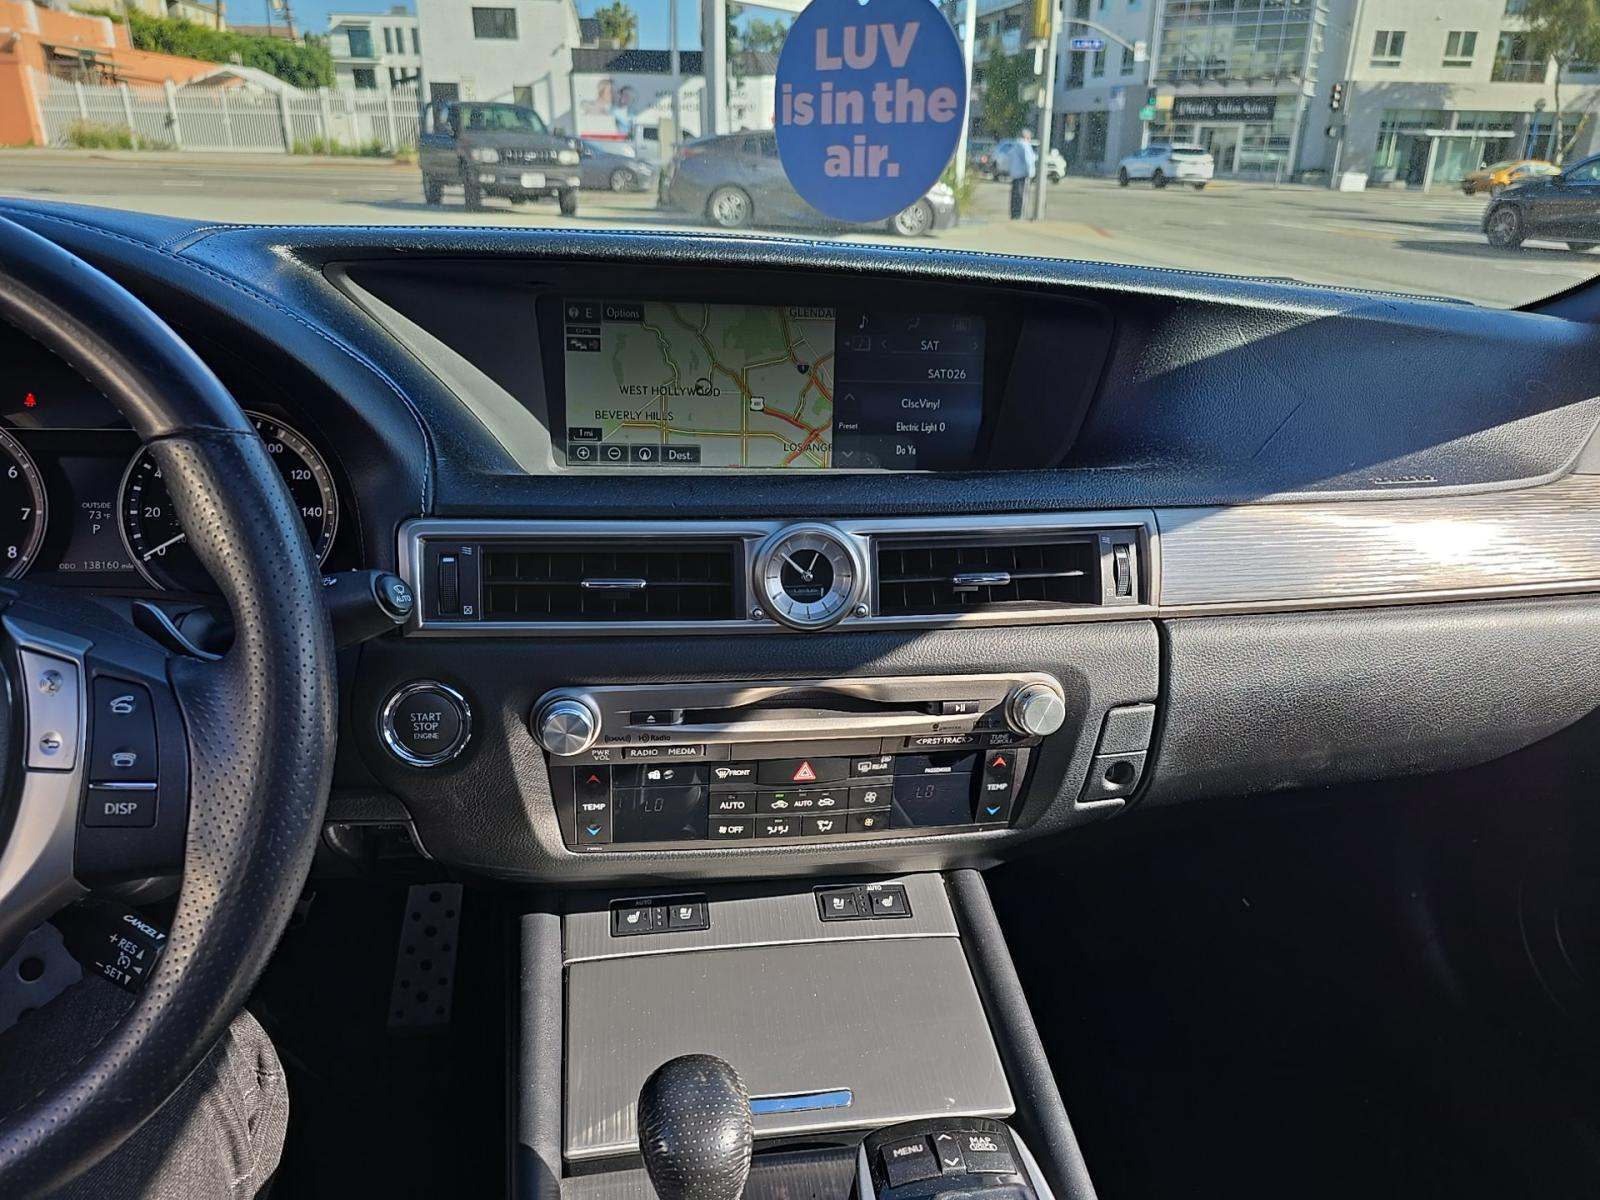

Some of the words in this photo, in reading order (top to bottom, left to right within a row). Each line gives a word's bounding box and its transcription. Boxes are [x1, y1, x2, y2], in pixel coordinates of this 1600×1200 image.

[815, 22, 920, 71] LUV
[782, 83, 814, 126] is
[821, 82, 864, 125] in
[872, 78, 957, 124] the
[824, 135, 900, 178] air.
[607, 307, 640, 319] Options
[920, 340, 940, 351] SAT
[928, 369, 967, 379] SAT026
[620, 385, 648, 395] WEST
[651, 386, 721, 397] HOLLYWOOD
[594, 410, 642, 421] BEVERLY
[645, 411, 674, 421] HILLS
[896, 422, 920, 431] Electric
[921, 422, 938, 434] Light
[263, 443, 283, 453] 00
[783, 442, 803, 452] LOS
[896, 445, 906, 455] Do
[668, 449, 693, 461] Dest.
[7, 466, 18, 478] 6
[290, 470, 311, 480] 120
[21, 507, 31, 520] 7
[88, 510, 102, 520] 73
[144, 507, 161, 517] 20
[301, 507, 322, 517] 140
[92, 524, 101, 535] P
[7, 546, 17, 558] 8
[83, 561, 119, 570] 138160
[410, 712, 442, 721] START
[413, 722, 439, 731] STOP
[413, 732, 440, 740] ENGINE
[987, 783, 1008, 791] TEMP
[104, 801, 138, 816] DISP
[719, 802, 745, 810] AUTO
[728, 826, 744, 834] OFF
[123, 914, 158, 938] CANCEL
[117, 938, 138, 955] RES
[104, 964, 124, 980] SET
[969, 1136, 991, 1144] MAP
[893, 1144, 924, 1158] MENU
